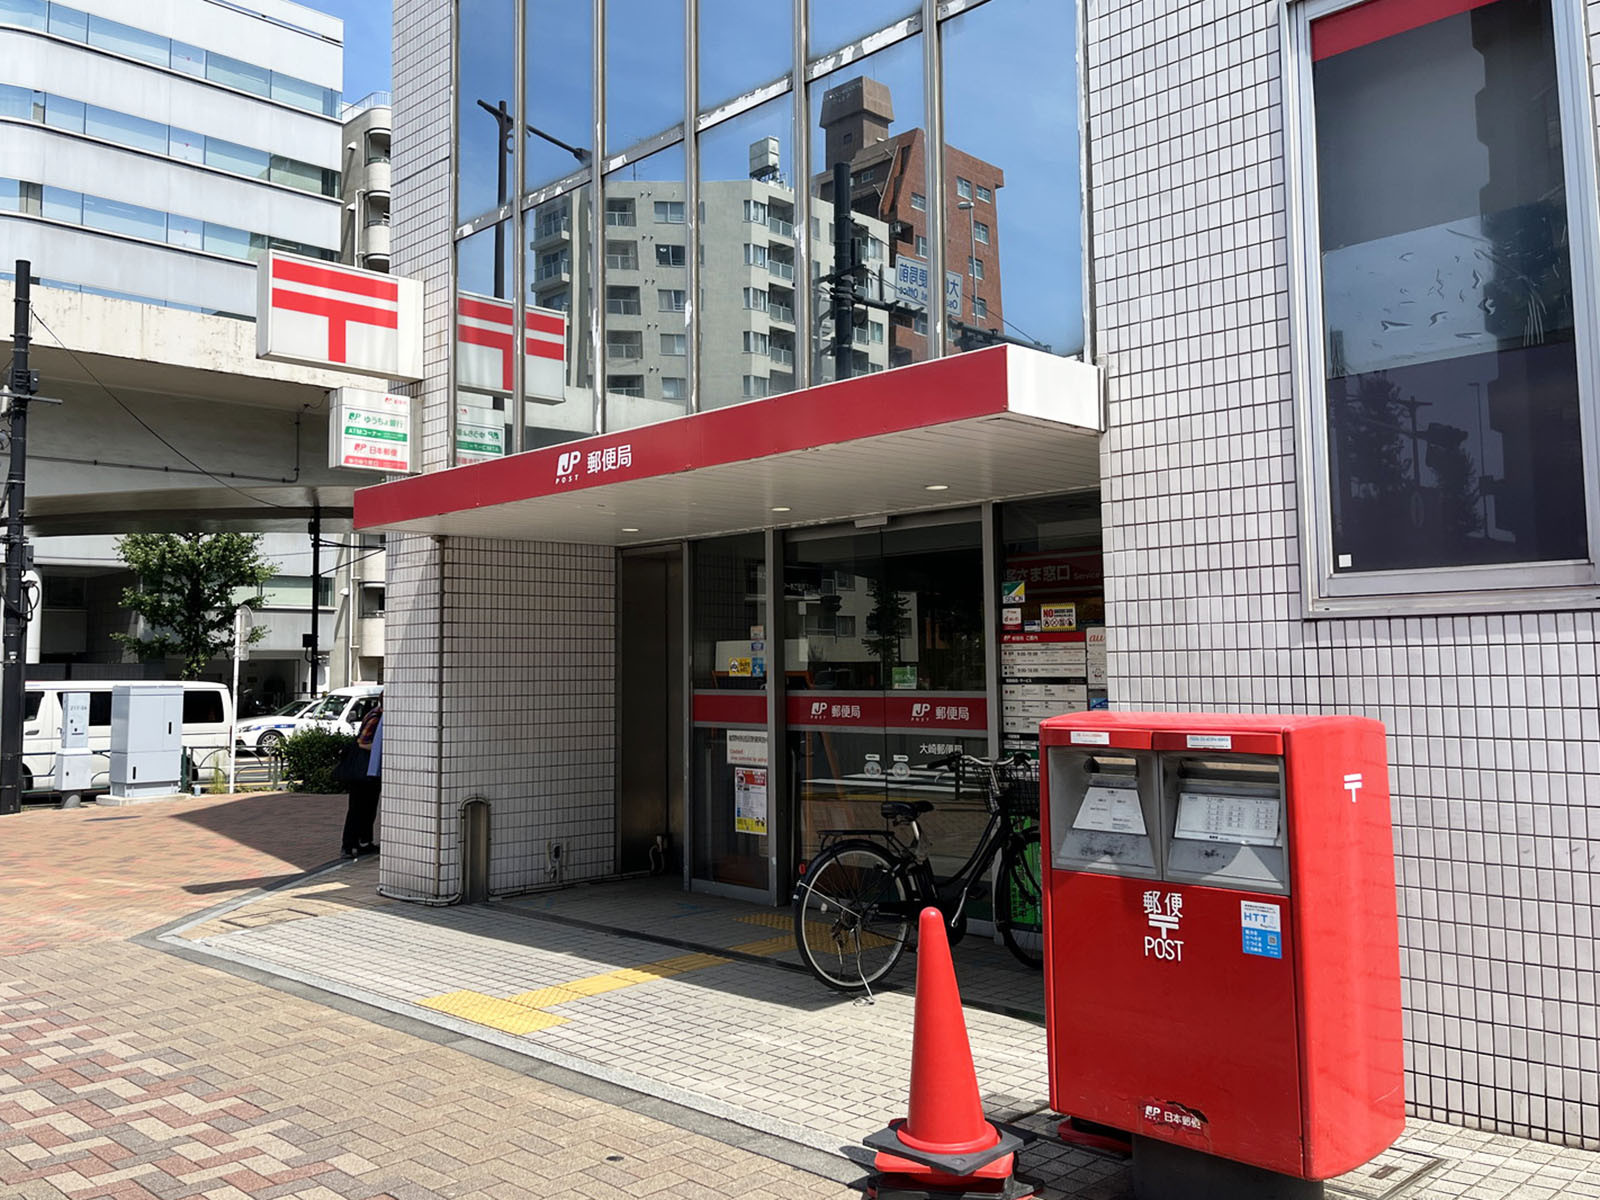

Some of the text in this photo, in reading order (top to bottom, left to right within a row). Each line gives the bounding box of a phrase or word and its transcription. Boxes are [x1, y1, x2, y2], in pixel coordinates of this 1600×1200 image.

[364, 415, 404, 429] ゆうちょ銀行
[348, 428, 382, 437] ATMコーナー
[369, 446, 398, 456] 日本郵便
[587, 444, 632, 474] 郵便局
[555, 474, 579, 485] POST
[1043, 608, 1054, 618] NO
[1089, 634, 1105, 643] au
[831, 704, 861, 719] 郵便局
[935, 705, 970, 721] 郵便局
[919, 744, 963, 755] 大崎郵便局
[1142, 891, 1184, 918] 郵便
[1243, 911, 1269, 923] HTT
[1145, 937, 1184, 961] POST
